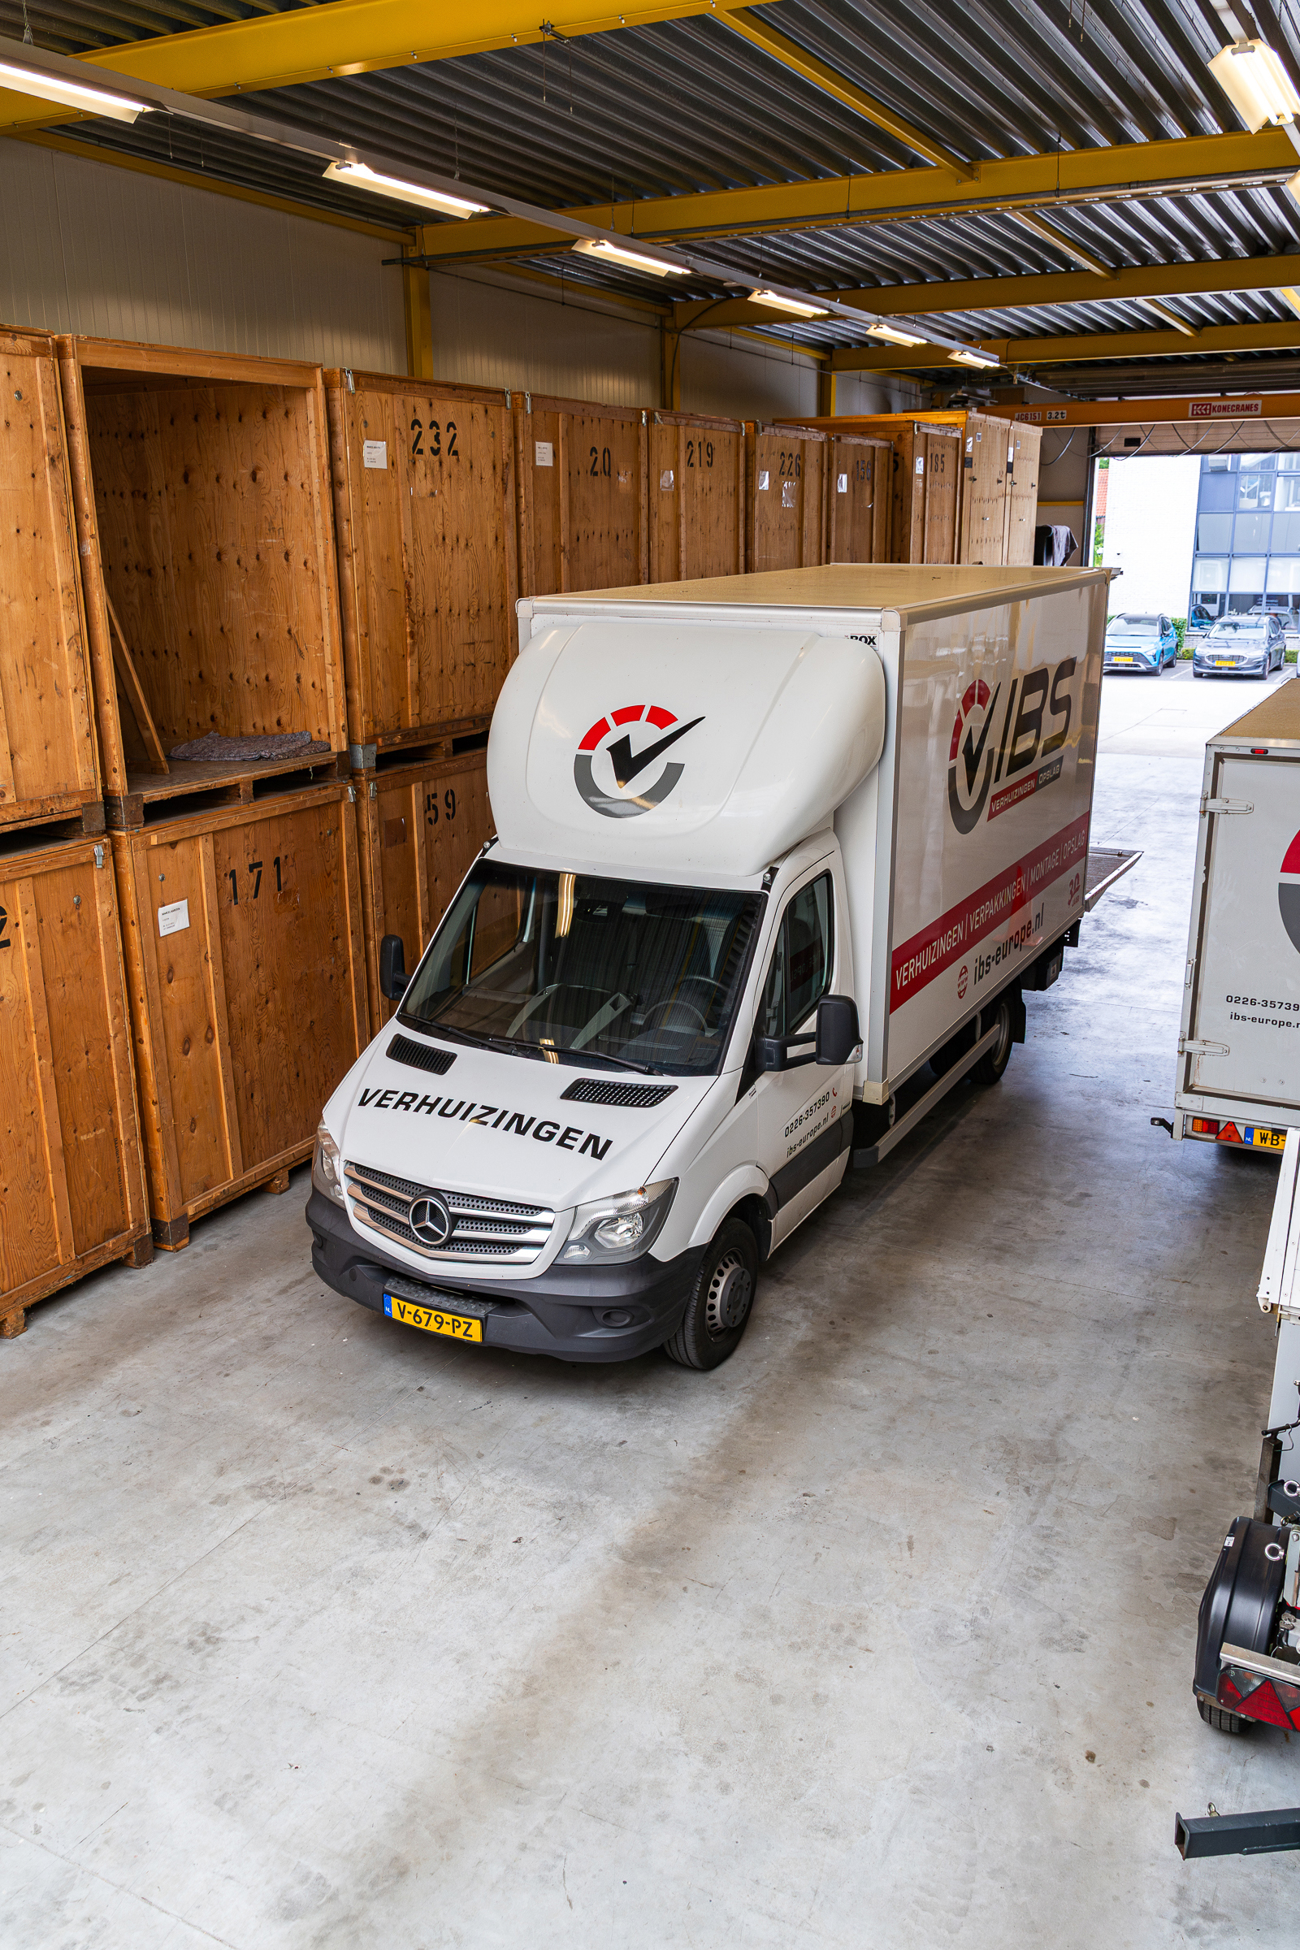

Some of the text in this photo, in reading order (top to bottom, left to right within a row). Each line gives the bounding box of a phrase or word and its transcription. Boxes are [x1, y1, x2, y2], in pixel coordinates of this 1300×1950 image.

[1016, 412, 1041, 421] JC6151
[1212, 403, 1259, 413] KONECRANES
[411, 418, 458, 456] 232
[687, 440, 713, 468] 219
[590, 446, 611, 477] 20
[779, 451, 801, 477] 226
[857, 459, 871, 481] 156
[930, 453, 945, 473] 185
[994, 656, 1077, 783] IBS
[427, 788, 456, 825] 59
[991, 764, 1060, 813] VERHUIZINGEN OPSLAG
[228, 856, 282, 905] 171
[896, 830, 1085, 991] VERHUIZINGEN VERPAKKINGEN MONTAGE OPSLAG
[973, 902, 1045, 985] ibs-europe.nl
[357, 1088, 614, 1161] VERHUIZINGEN
[784, 1091, 830, 1138] 0226-357390
[786, 1112, 829, 1158] ibs-europe.nl
[397, 1302, 473, 1338] V-679-PZ
